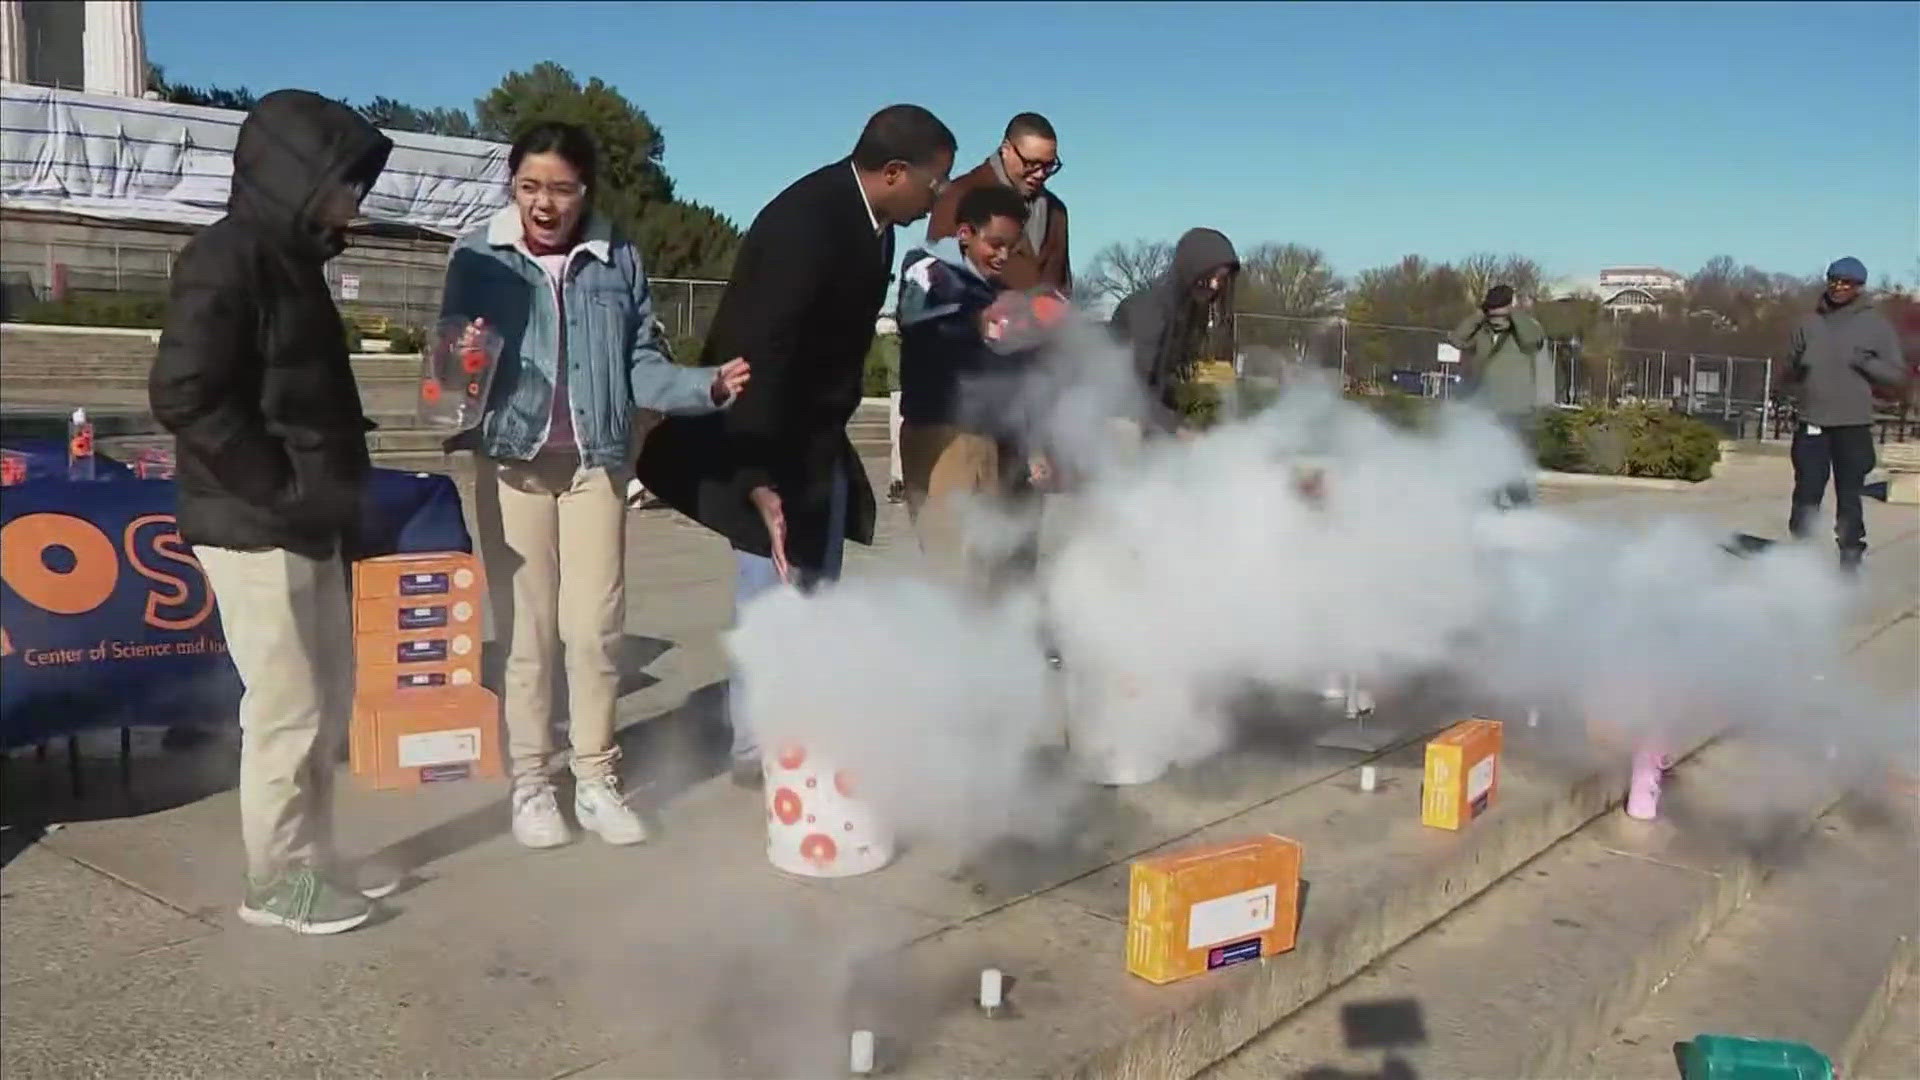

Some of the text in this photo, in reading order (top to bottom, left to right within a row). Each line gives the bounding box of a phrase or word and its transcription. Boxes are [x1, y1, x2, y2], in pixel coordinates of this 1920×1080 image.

[0, 512, 216, 631] OS
[24, 648, 83, 667] Center
[90, 639, 106, 660] of
[112, 640, 171, 659] Science
[176, 635, 206, 655] and
